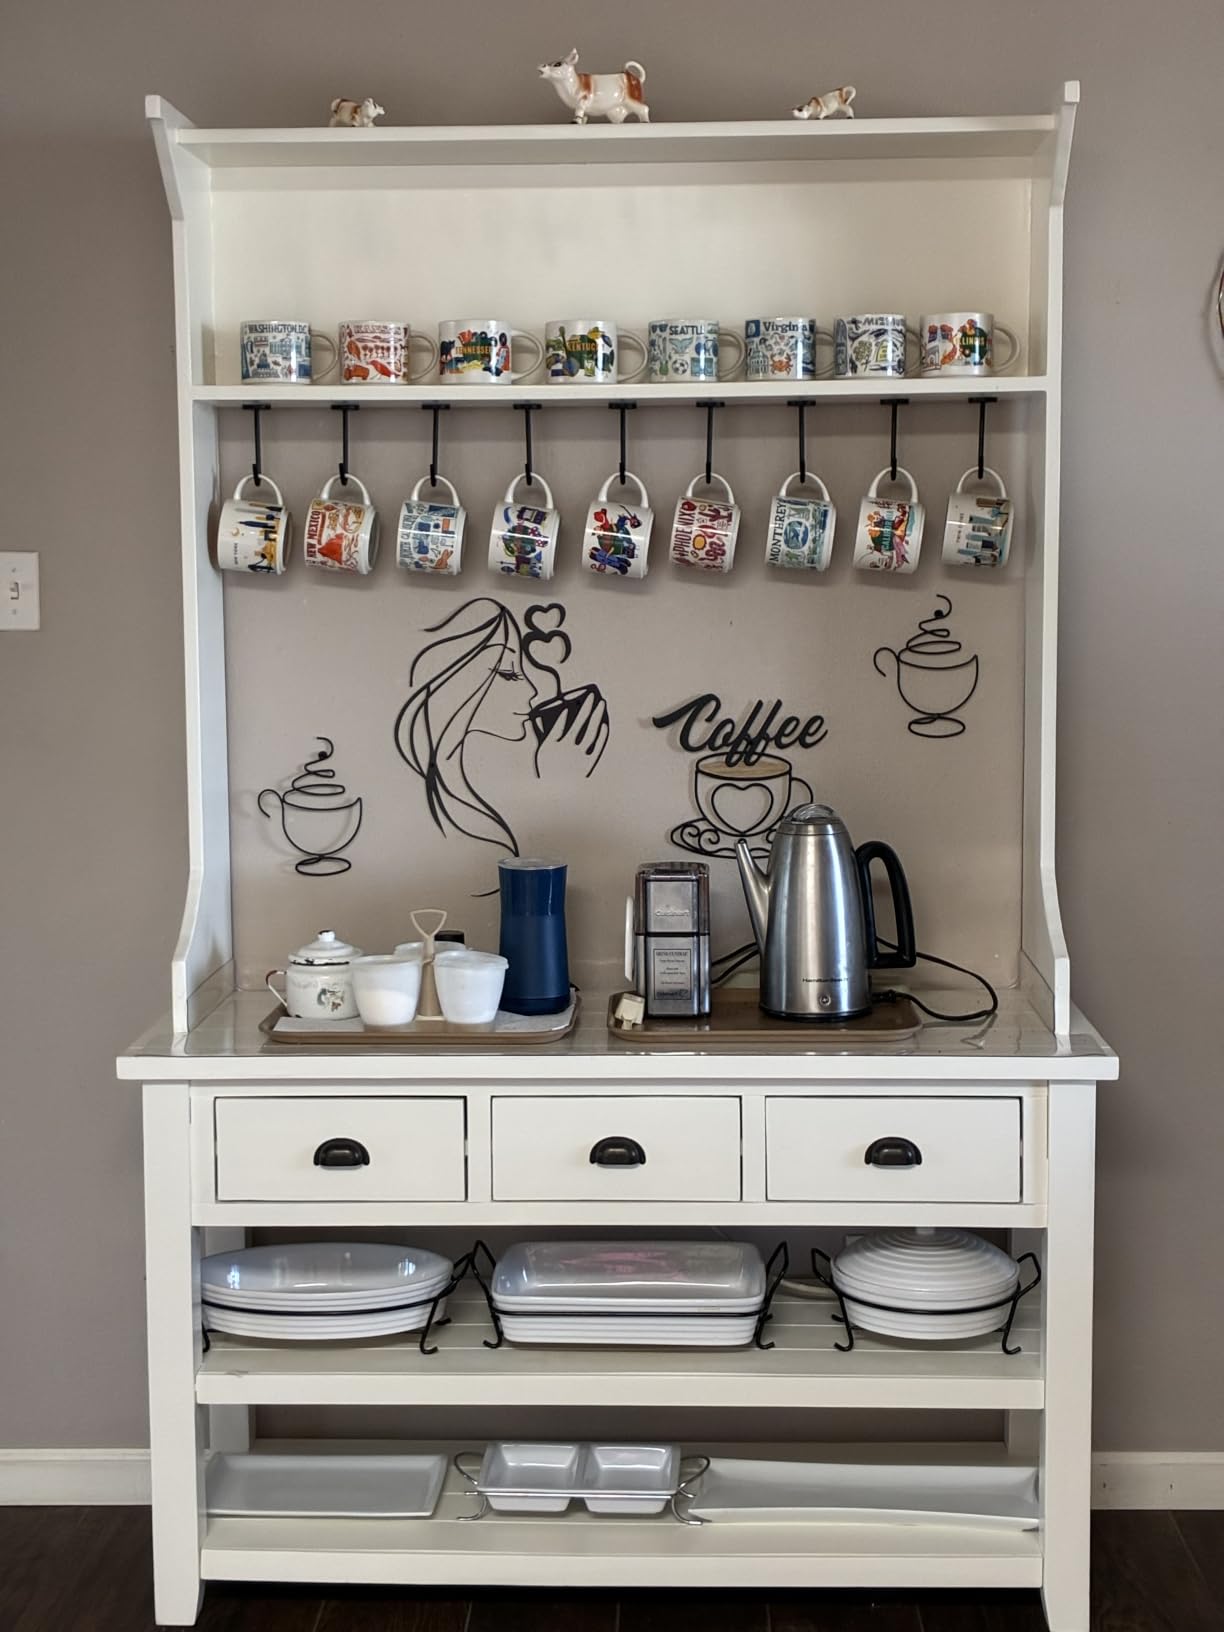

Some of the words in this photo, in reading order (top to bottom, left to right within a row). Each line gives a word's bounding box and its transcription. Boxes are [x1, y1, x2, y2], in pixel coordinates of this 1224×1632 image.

[308, 510, 321, 541] MEXICO
[672, 510, 696, 553] PHOENIX
[769, 502, 786, 562] MONTEREY
[306, 541, 317, 559] NEW
[652, 693, 828, 767] Coffee
